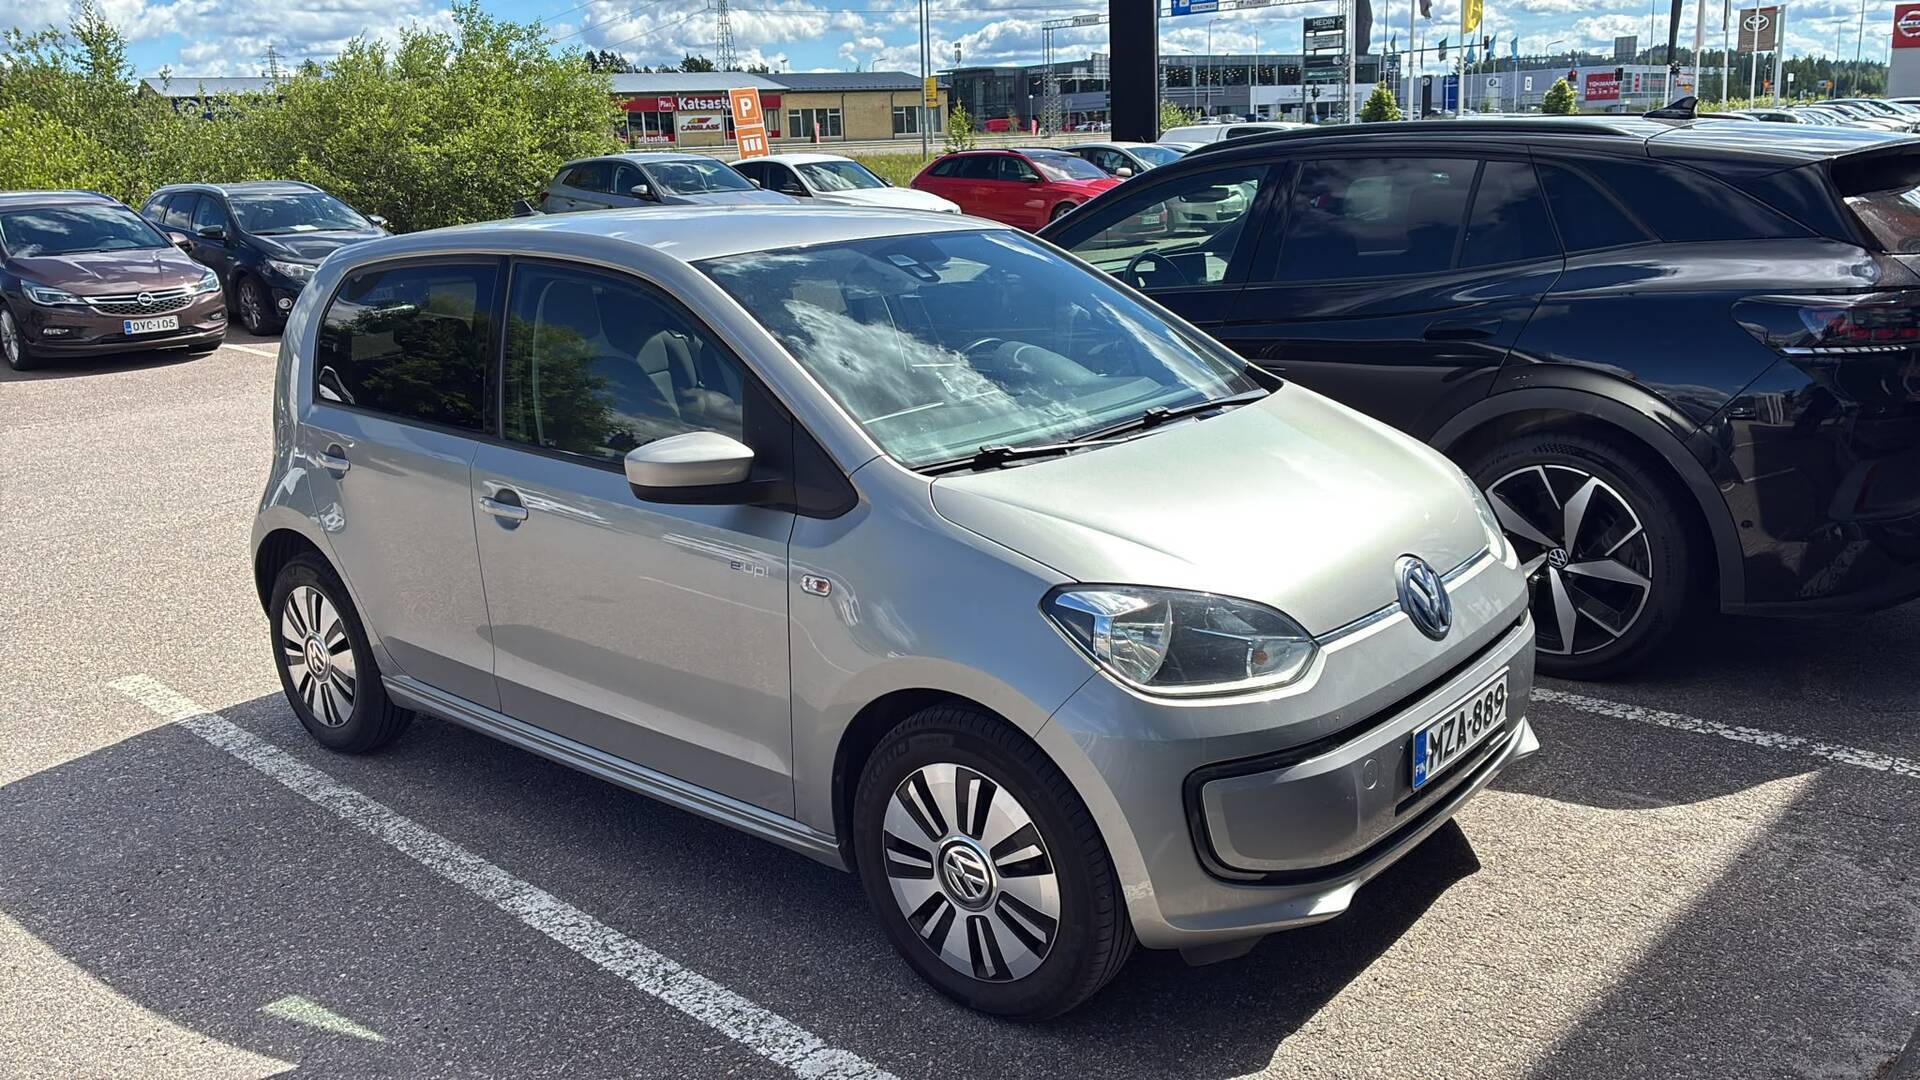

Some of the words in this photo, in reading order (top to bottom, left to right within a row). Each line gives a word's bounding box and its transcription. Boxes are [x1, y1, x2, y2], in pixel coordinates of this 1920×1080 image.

[1312, 18, 1336, 26] HEDIN
[678, 97, 732, 110] Katsastu
[739, 98, 752, 117] P
[1428, 682, 1505, 772] MZA-889
